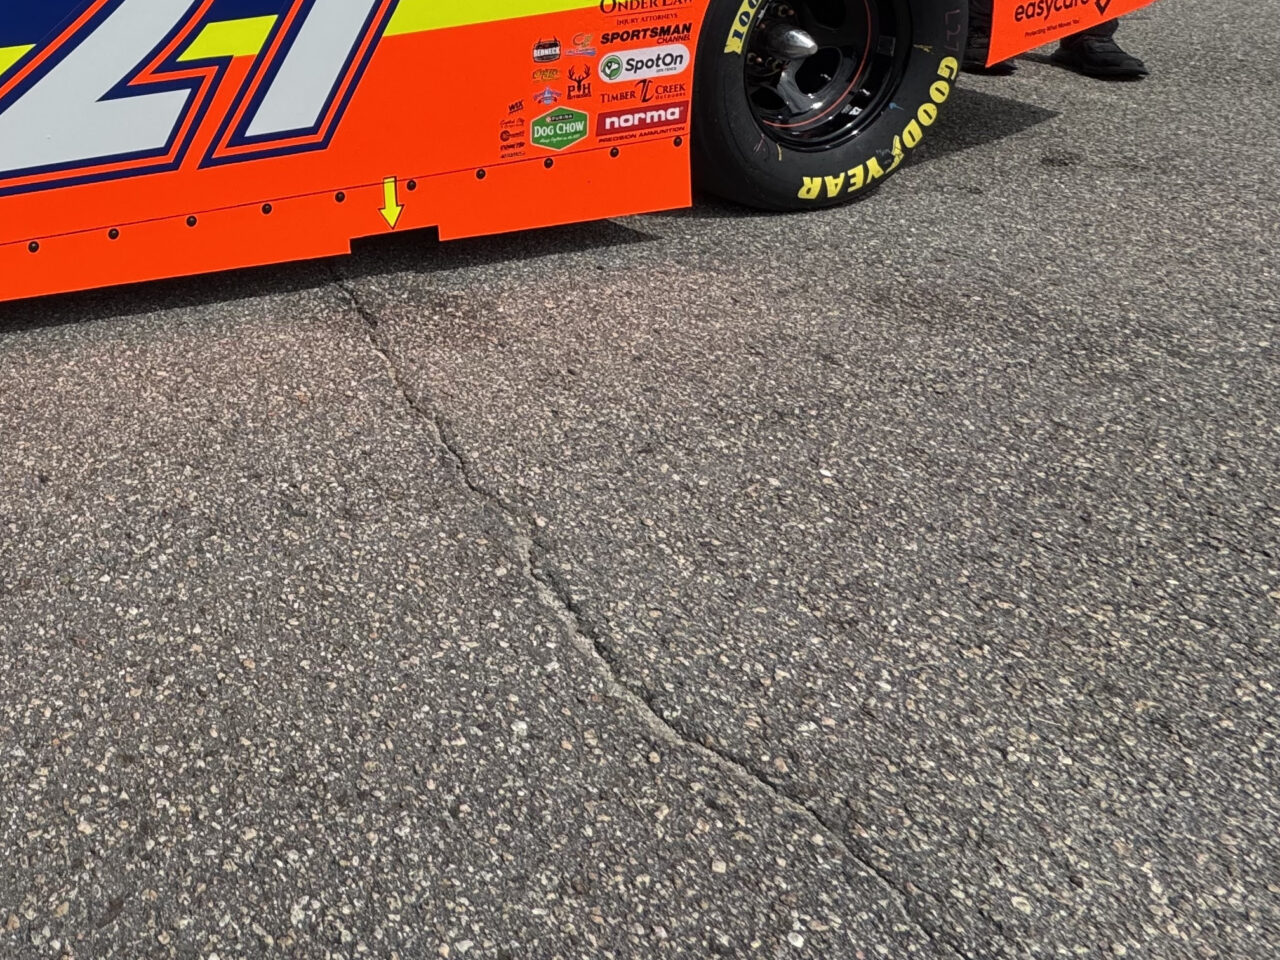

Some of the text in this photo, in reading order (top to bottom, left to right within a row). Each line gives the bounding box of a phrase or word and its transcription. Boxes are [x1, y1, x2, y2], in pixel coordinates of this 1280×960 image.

[600, 23, 692, 45] SPORTSMAN
[657, 34, 690, 44] CHANNEL
[625, 53, 683, 74] SpotOn
[601, 91, 636, 103] TIMBER
[655, 83, 686, 94] CREEK
[605, 107, 680, 129] norma
[534, 125, 554, 138] DOG
[556, 121, 585, 134] CHOW
